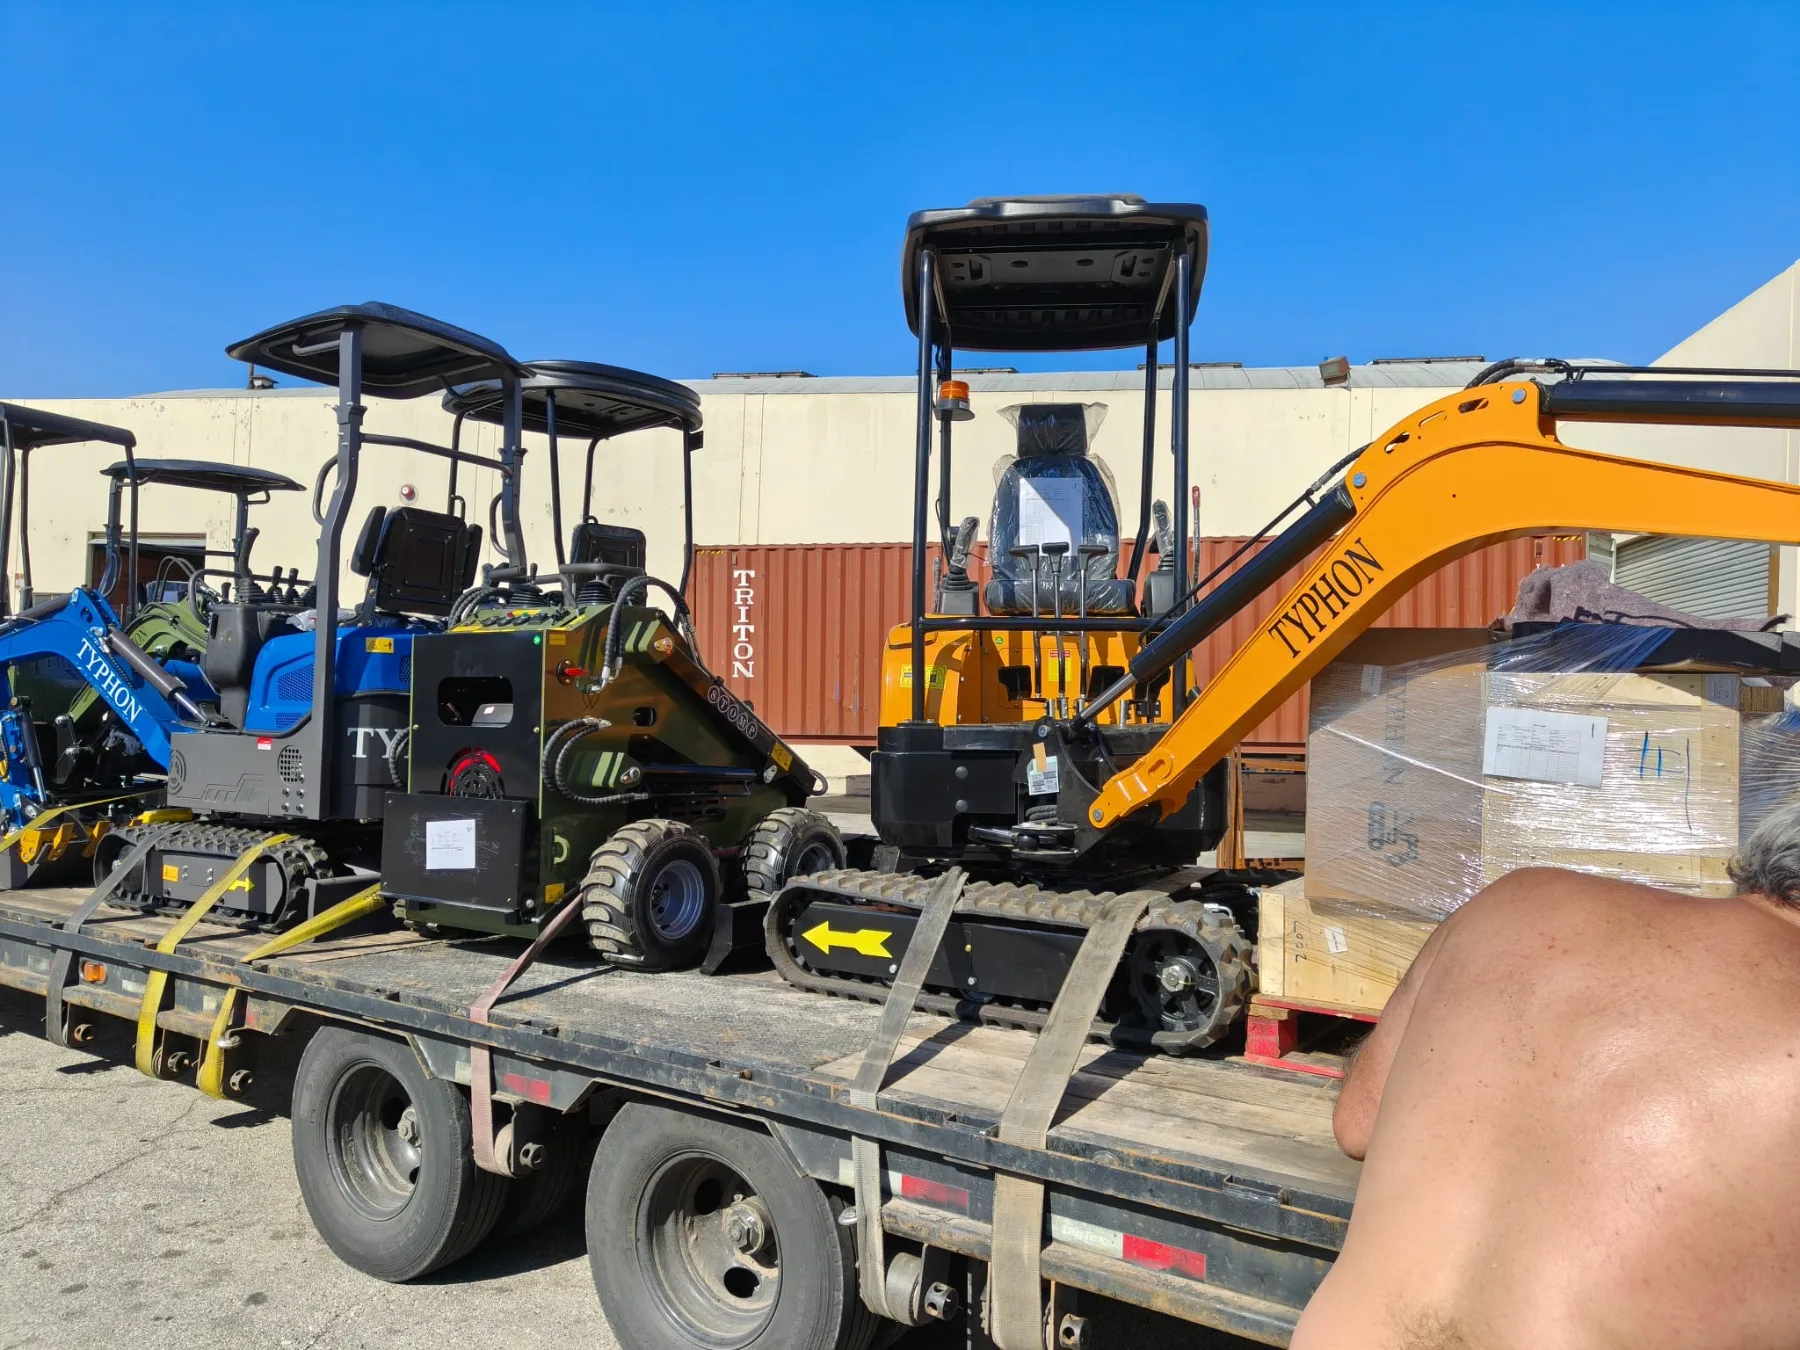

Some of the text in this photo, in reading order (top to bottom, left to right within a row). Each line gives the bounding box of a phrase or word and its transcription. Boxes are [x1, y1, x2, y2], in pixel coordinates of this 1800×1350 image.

[732, 569, 755, 678] TRITON
[1267, 537, 1385, 659] TYPHON
[76, 638, 143, 724] TYPHON
[709, 687, 757, 738] STOMP
[347, 727, 410, 759] TY
[1382, 673, 1408, 788] TYPHN
